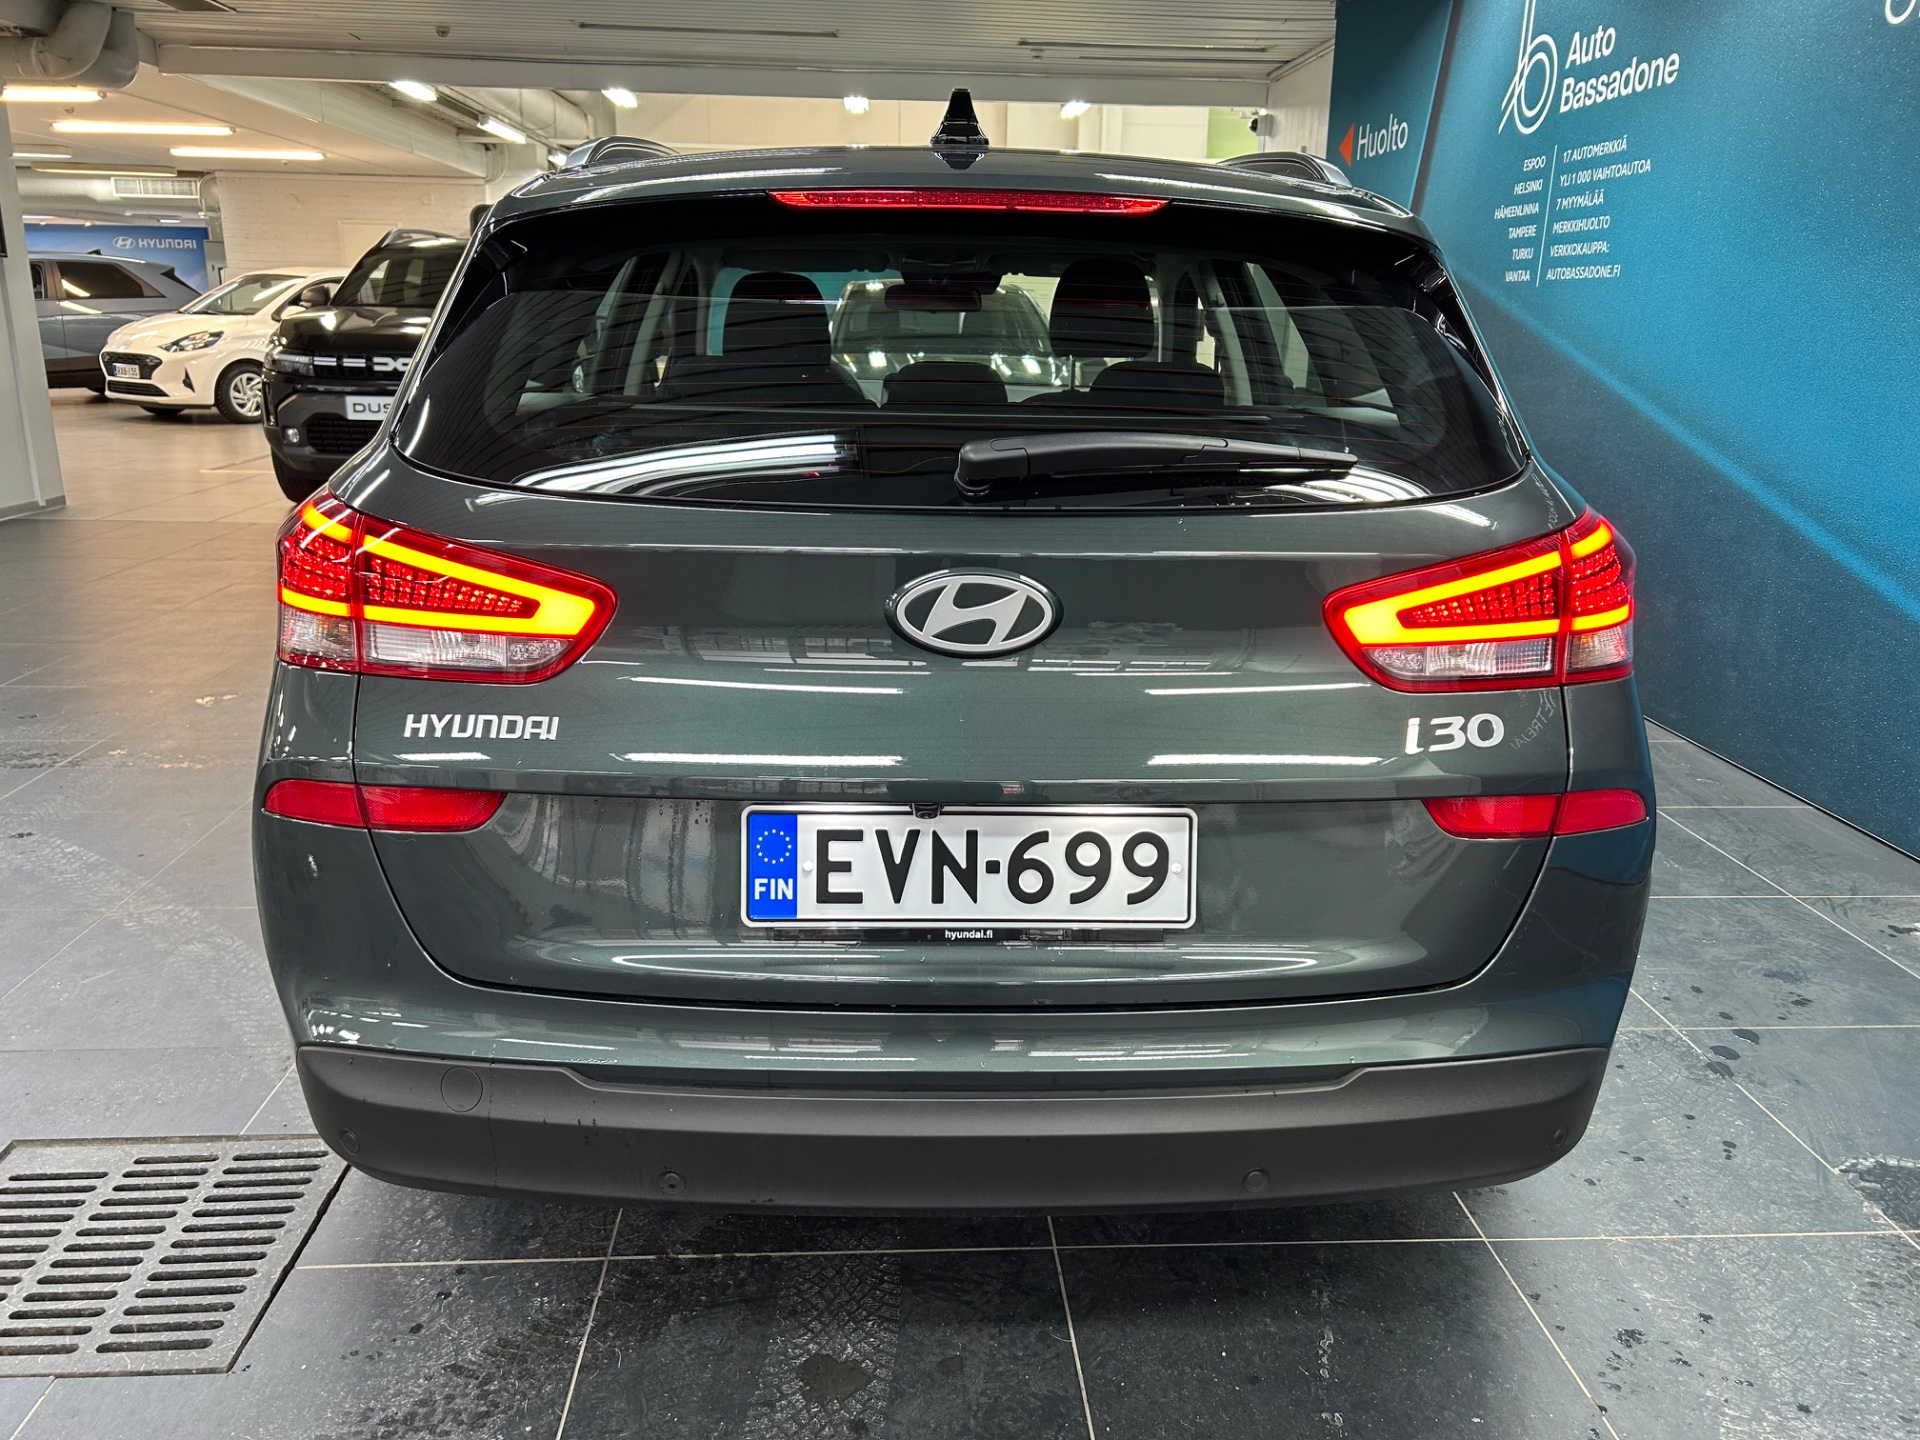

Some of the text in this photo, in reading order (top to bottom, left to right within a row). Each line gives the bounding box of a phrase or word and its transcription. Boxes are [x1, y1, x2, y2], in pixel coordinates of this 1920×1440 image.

[1565, 25, 1616, 69] Auto
[1559, 52, 1680, 114] Bassadone
[1356, 113, 1409, 160] Huolto
[1563, 135, 1627, 163] 17 AUTOMERKKIÄ
[1523, 155, 1546, 171] ESPOO
[1560, 174, 1572, 187] YLI
[1576, 169, 1592, 184] 000
[1592, 159, 1651, 181] VAIHTOAUTOA
[1513, 179, 1543, 195] HELSINKI
[1556, 189, 1604, 210] 7 MYYMÄLÄÄ
[1494, 202, 1539, 219] HÄMEENLINNA
[1508, 225, 1538, 239] TAMPERE
[1552, 215, 1610, 234] MERKKIHUOLTO
[138, 238, 197, 249] HYUNDAI
[1550, 241, 1610, 257] VERKKOKAUPPA:
[1512, 247, 1534, 260] TURKU
[1505, 270, 1530, 282] VANTAA
[1546, 264, 1621, 280] AUTOBASSADONE.FI
[403, 713, 560, 741] HYUNDAI
[815, 829, 1170, 905] EVN-699
[753, 877, 794, 901] FIN
[944, 929, 993, 941] hyundai.fi
